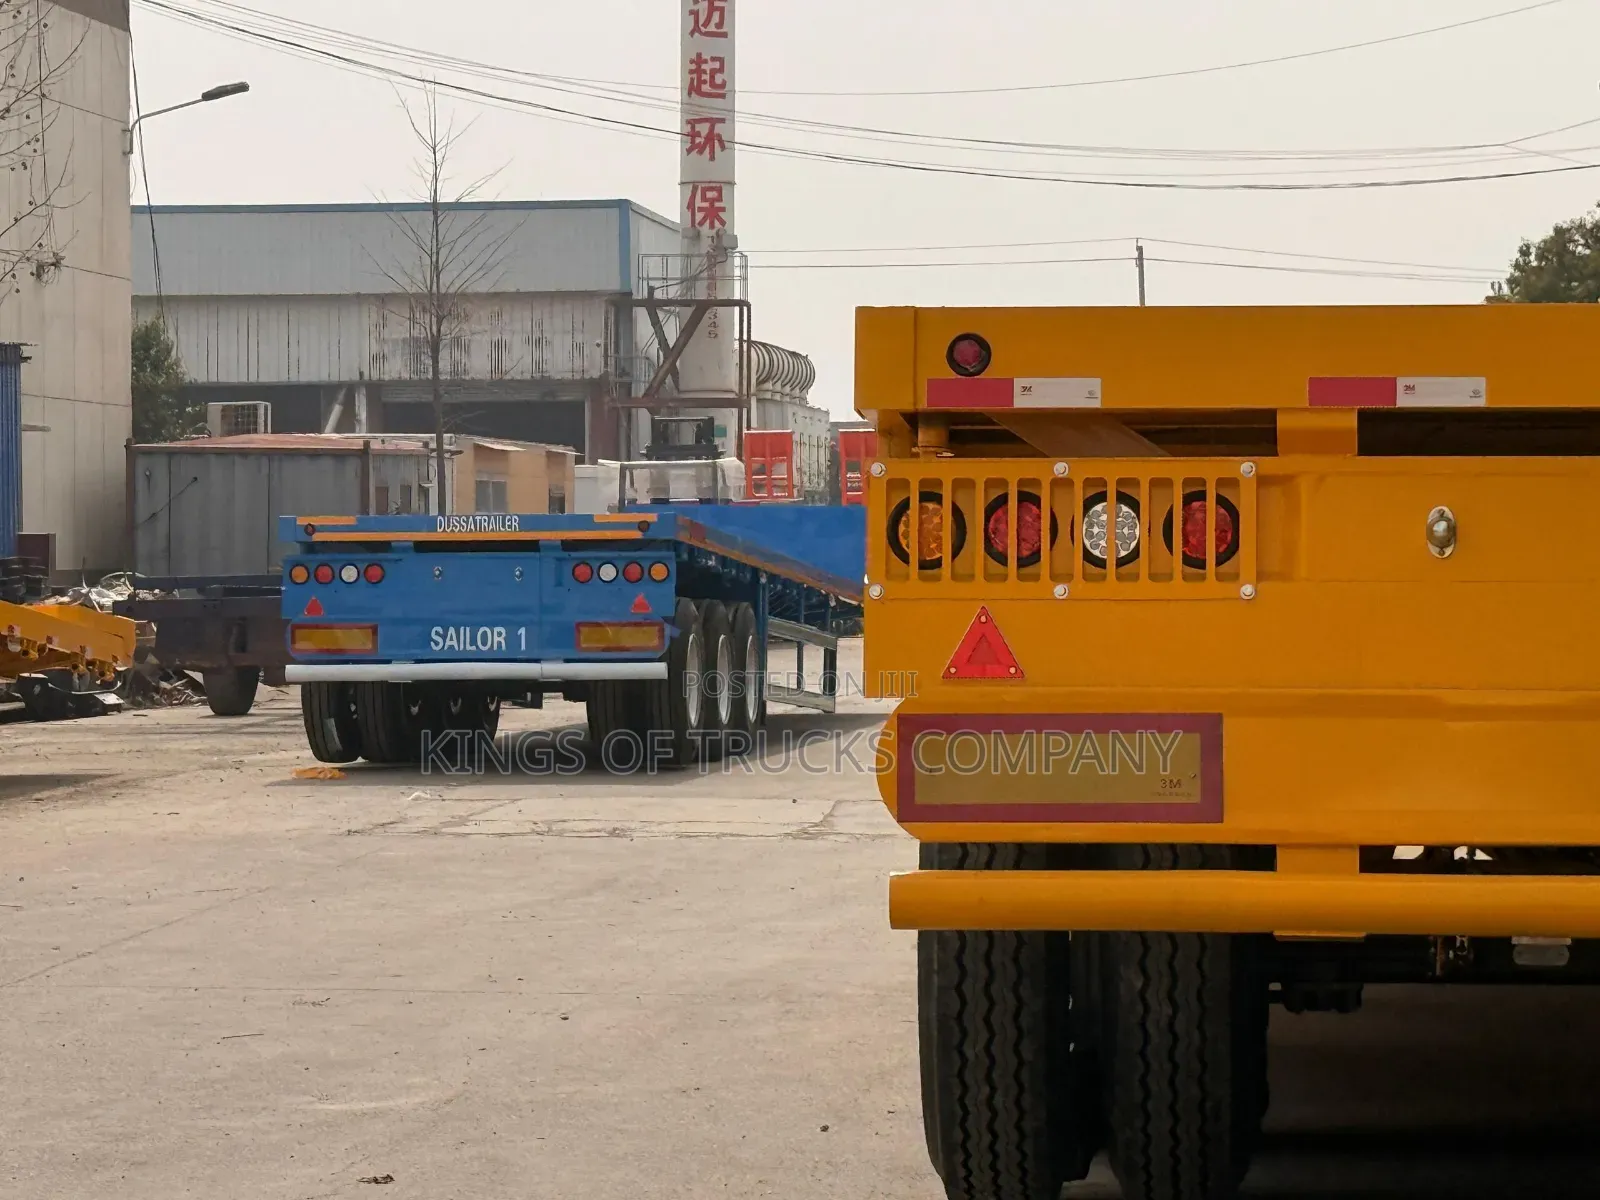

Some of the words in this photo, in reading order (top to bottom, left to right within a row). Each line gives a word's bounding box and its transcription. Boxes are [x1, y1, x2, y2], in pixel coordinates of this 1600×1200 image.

[686, 0, 728, 230] 迈起环保
[437, 515, 520, 532] DUSSATRAILER
[430, 626, 506, 651] SAILOR
[517, 626, 526, 651] 1
[1160, 779, 1182, 789] 3M
